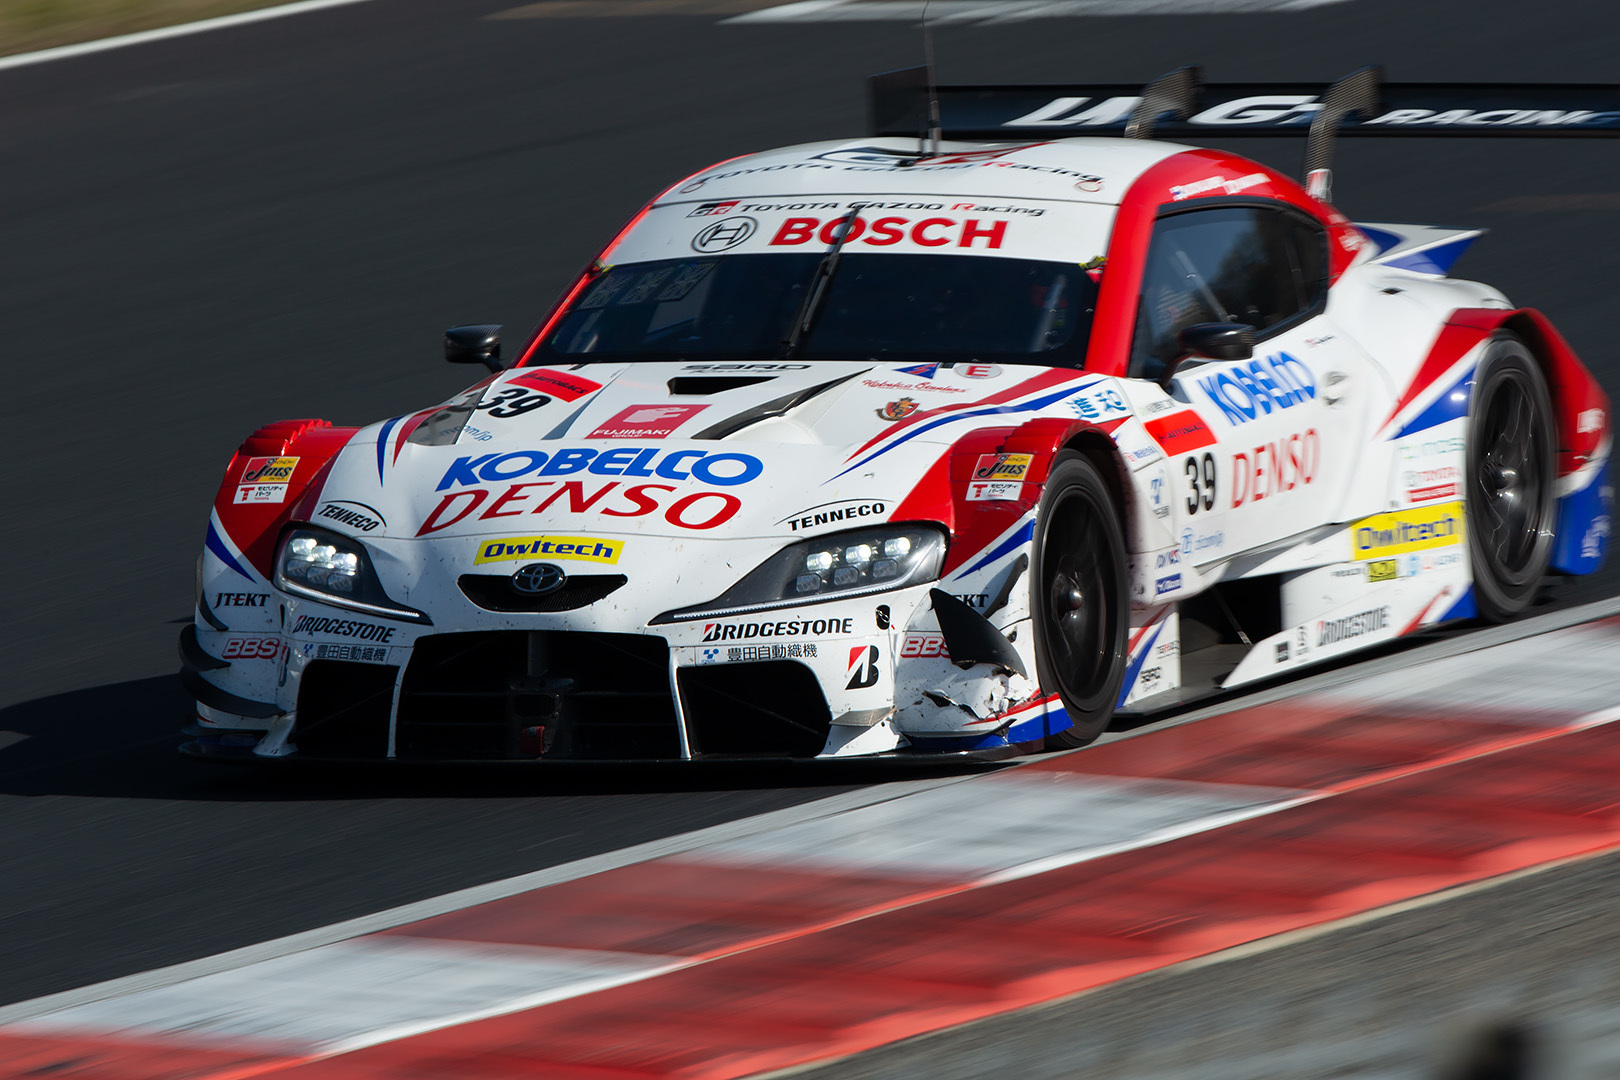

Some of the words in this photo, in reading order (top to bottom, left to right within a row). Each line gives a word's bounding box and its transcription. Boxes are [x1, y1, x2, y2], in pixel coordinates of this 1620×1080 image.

[979, 161, 1104, 182] Racing
[740, 202, 840, 213] TOYOTA
[846, 201, 944, 211] GAZOO
[951, 203, 1047, 217] Racing
[768, 217, 1009, 249] BOSCH
[476, 388, 552, 418] 39
[435, 448, 764, 492] KOBELCO
[1230, 428, 1320, 509] DENSO
[1184, 452, 1216, 515] 39
[318, 504, 380, 532] TENNECO
[415, 481, 742, 538] DENSO
[788, 503, 886, 531] TENNECO
[484, 540, 614, 559] Owltech
[213, 592, 271, 609] JTEKT
[293, 615, 397, 643] BRIDGESTONE
[702, 618, 853, 643] BRIDGESTONE
[221, 637, 281, 660] BBS
